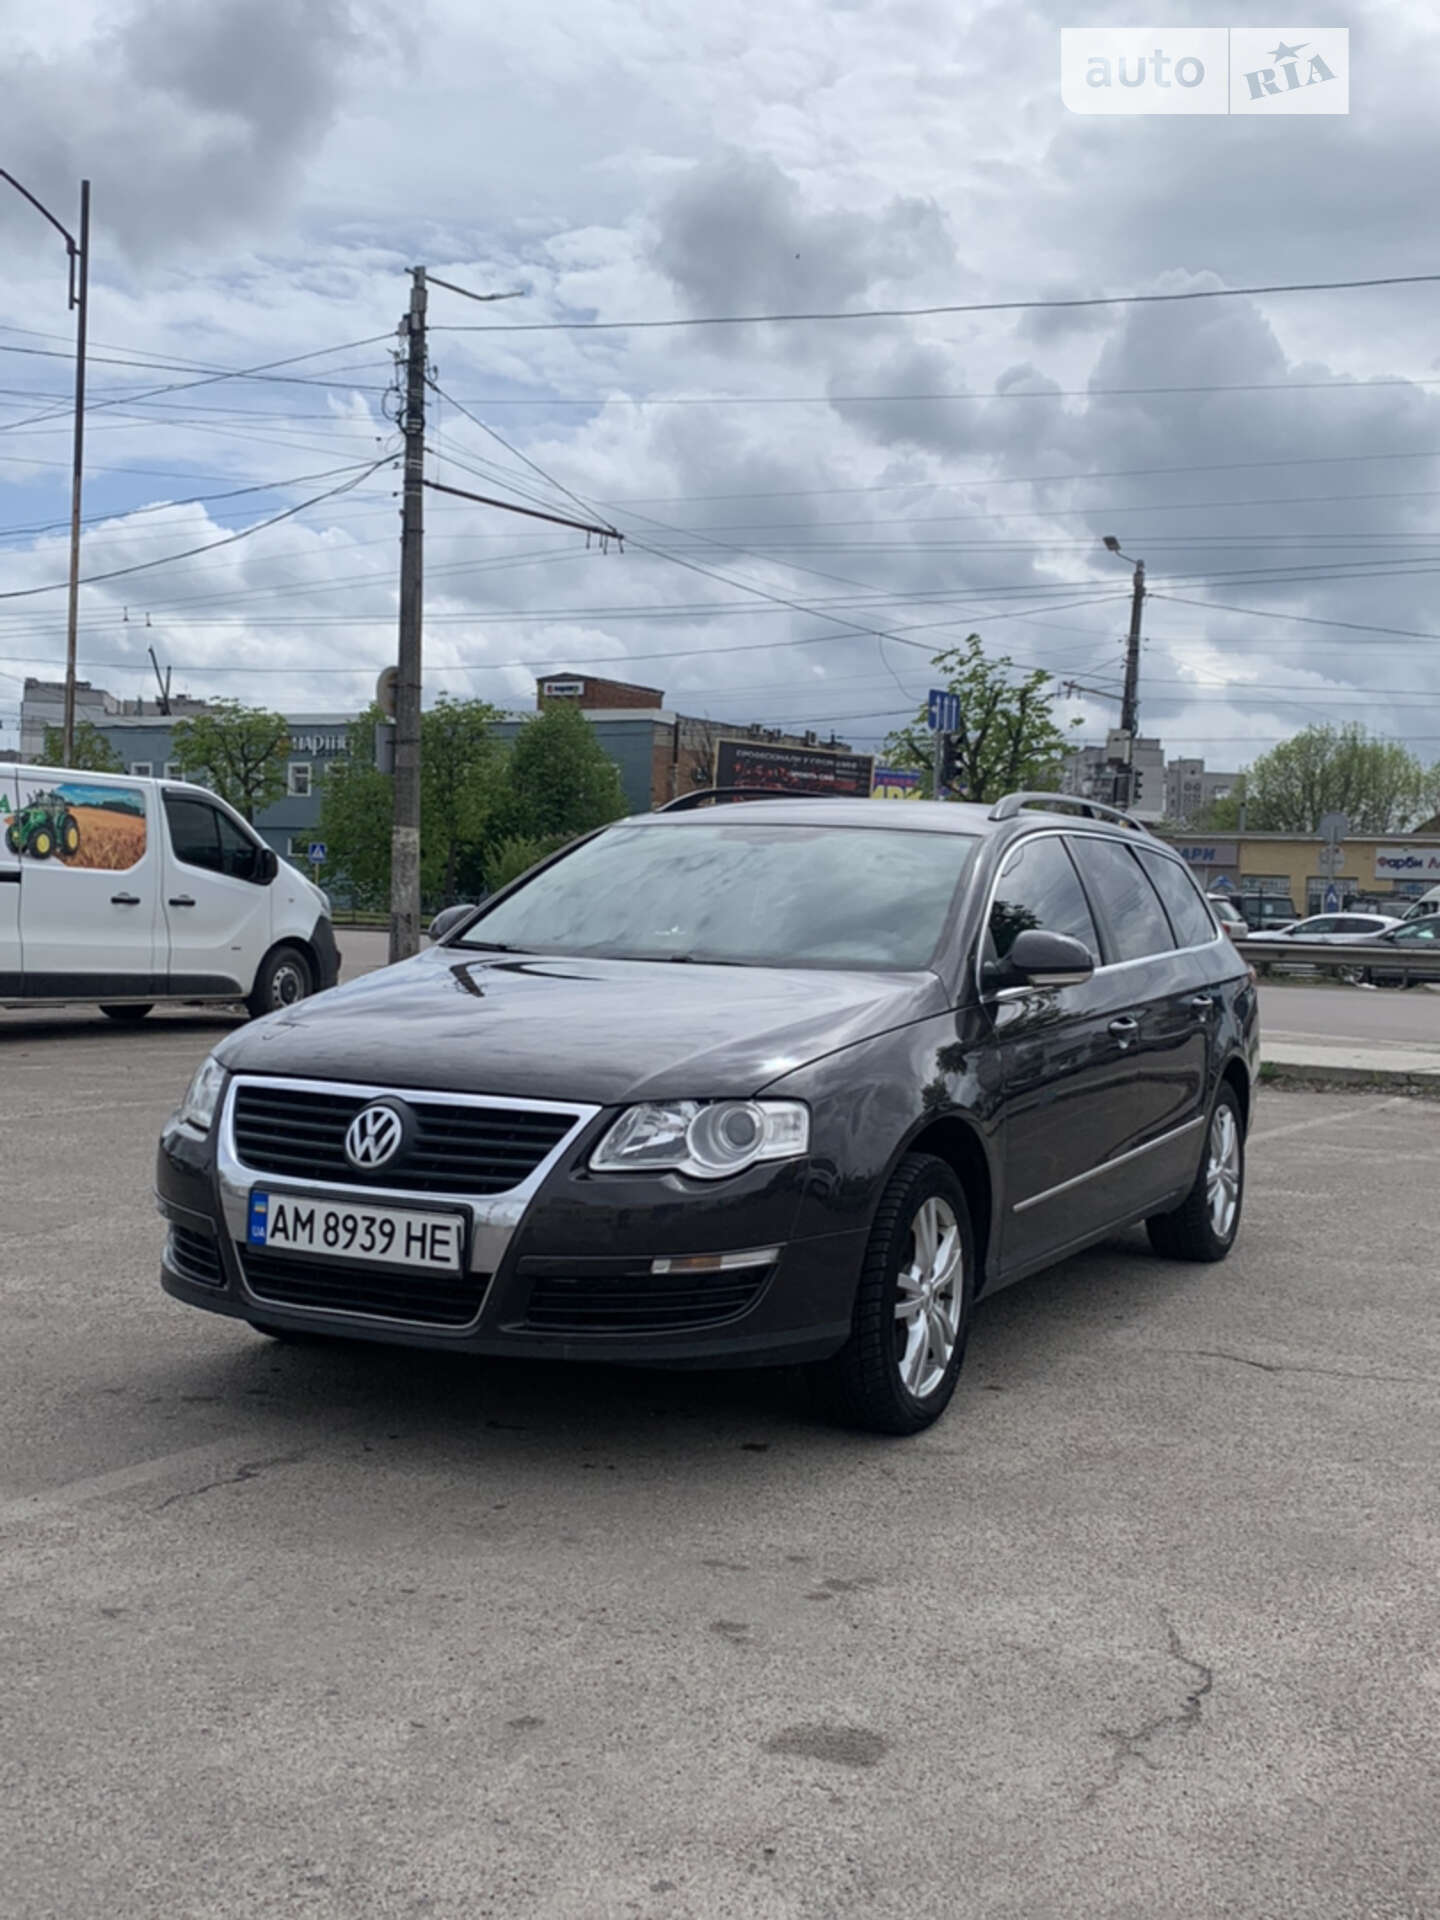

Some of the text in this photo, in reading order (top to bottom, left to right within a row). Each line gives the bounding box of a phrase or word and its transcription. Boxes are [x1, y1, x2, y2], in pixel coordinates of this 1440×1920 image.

[1175, 847, 1216, 861] АРИ
[1377, 856, 1423, 871] Фарби
[270, 1204, 452, 1262] AM 8939 HE
